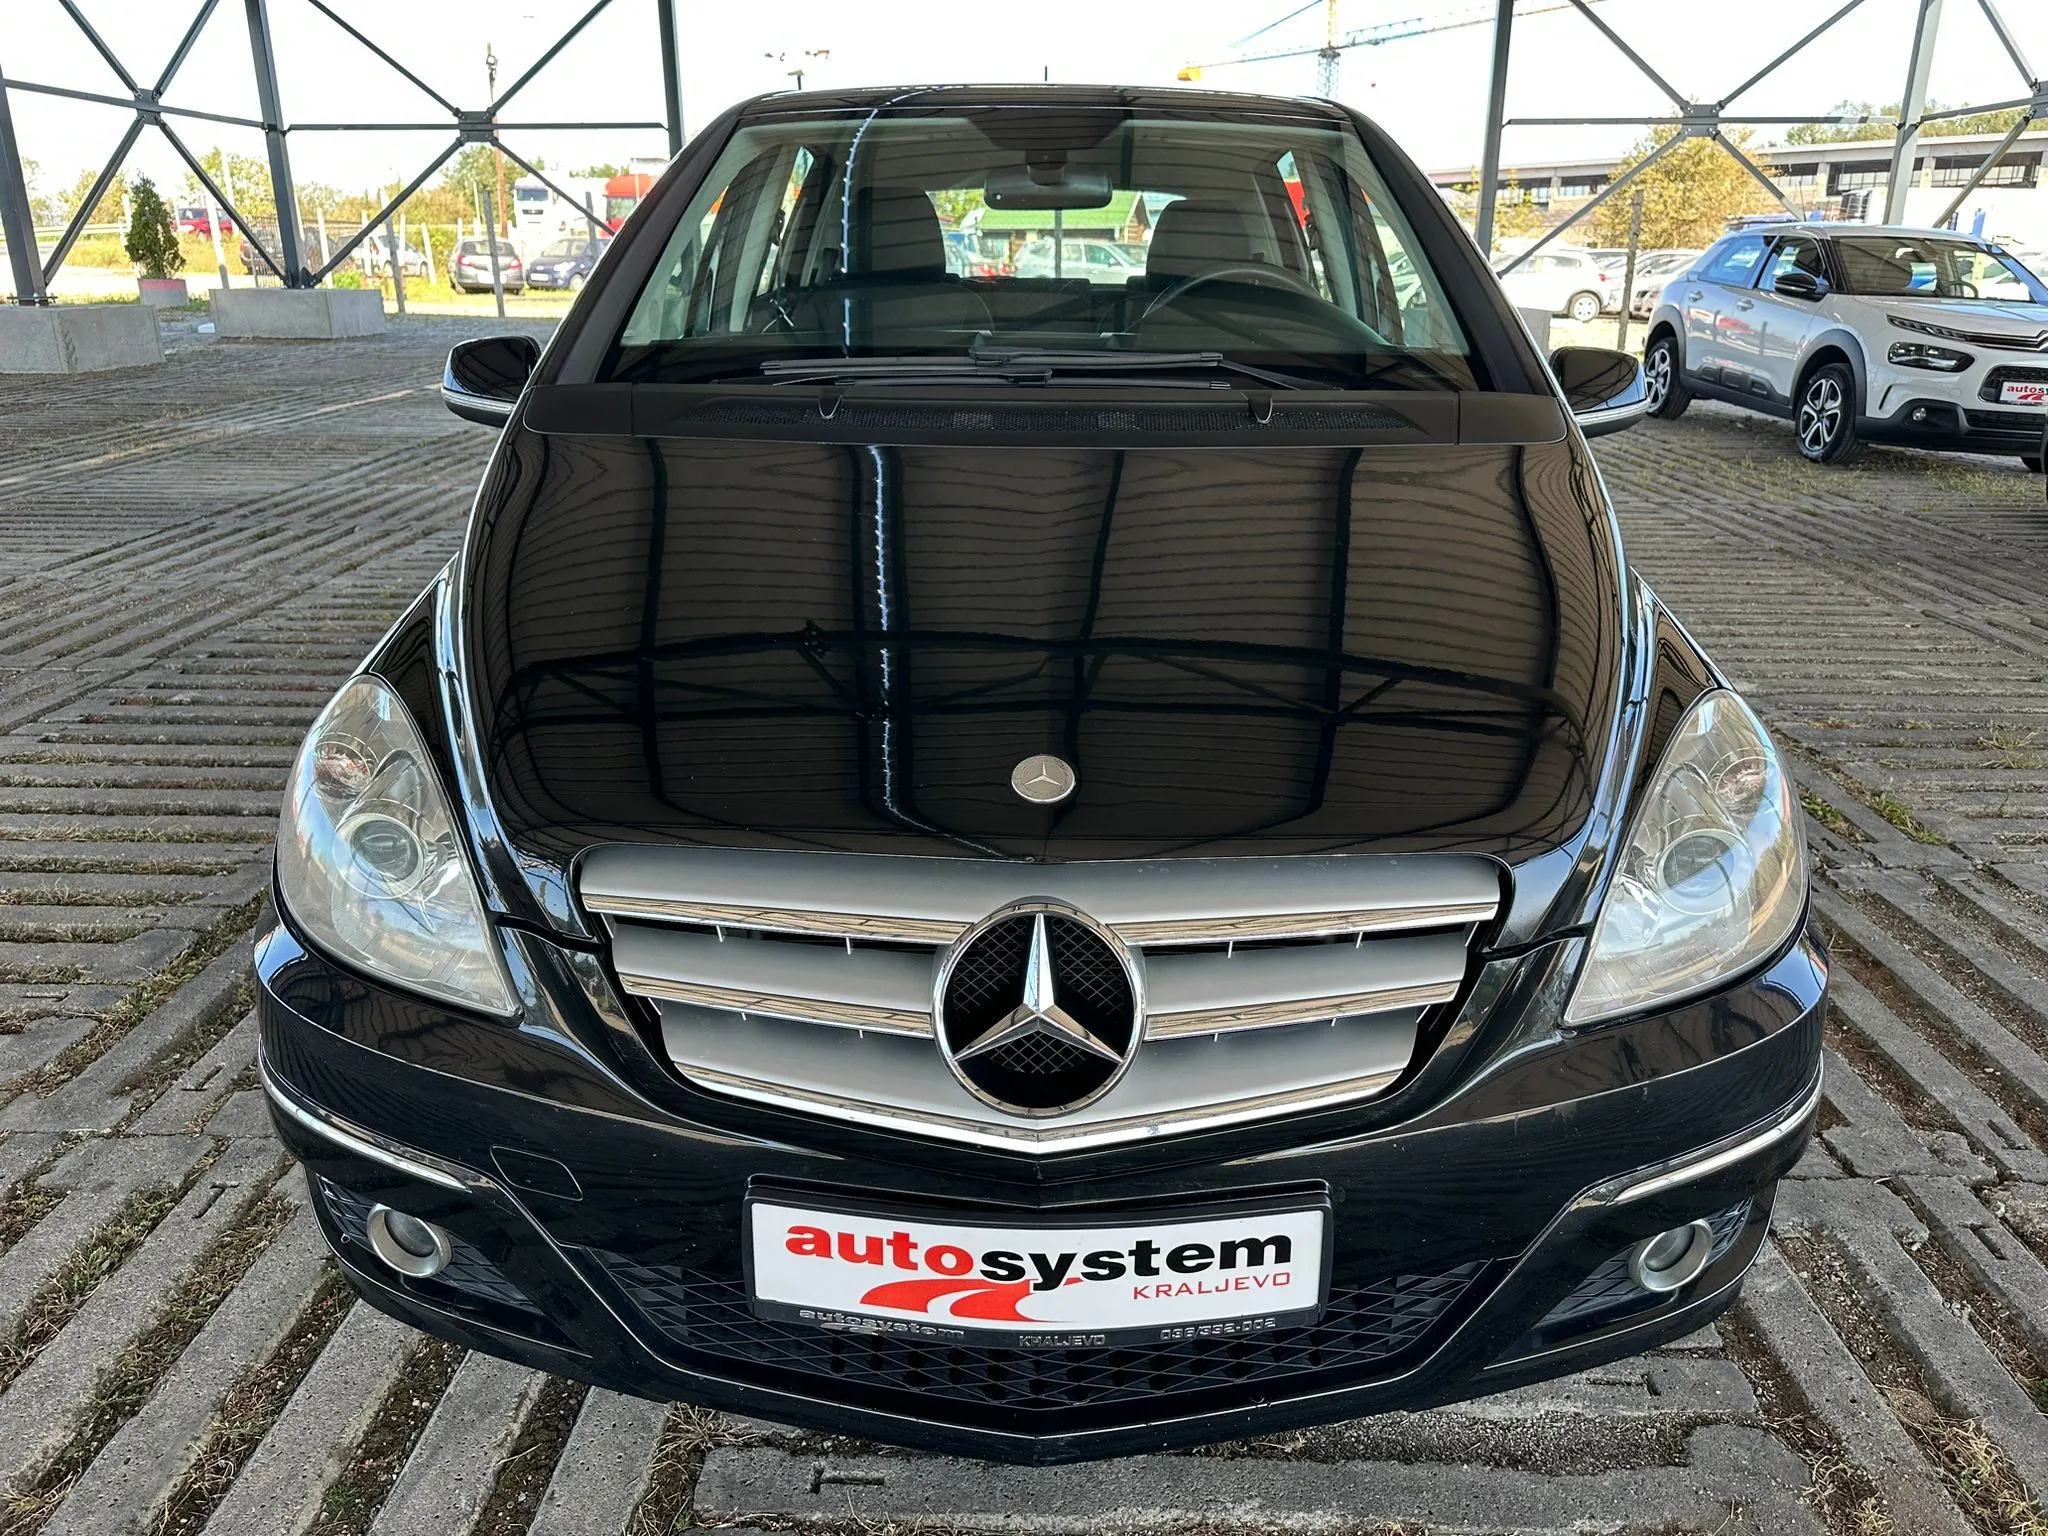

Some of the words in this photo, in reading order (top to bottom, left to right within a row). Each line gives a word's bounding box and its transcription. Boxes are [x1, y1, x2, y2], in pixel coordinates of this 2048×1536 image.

[785, 1225, 1292, 1291] autosystem
[1132, 1272, 1291, 1300] KRALJEVO
[799, 1309, 964, 1338] autosystem
[1019, 1335, 1106, 1347] KRALJEVO
[1160, 1317, 1276, 1341] 036/332-002
